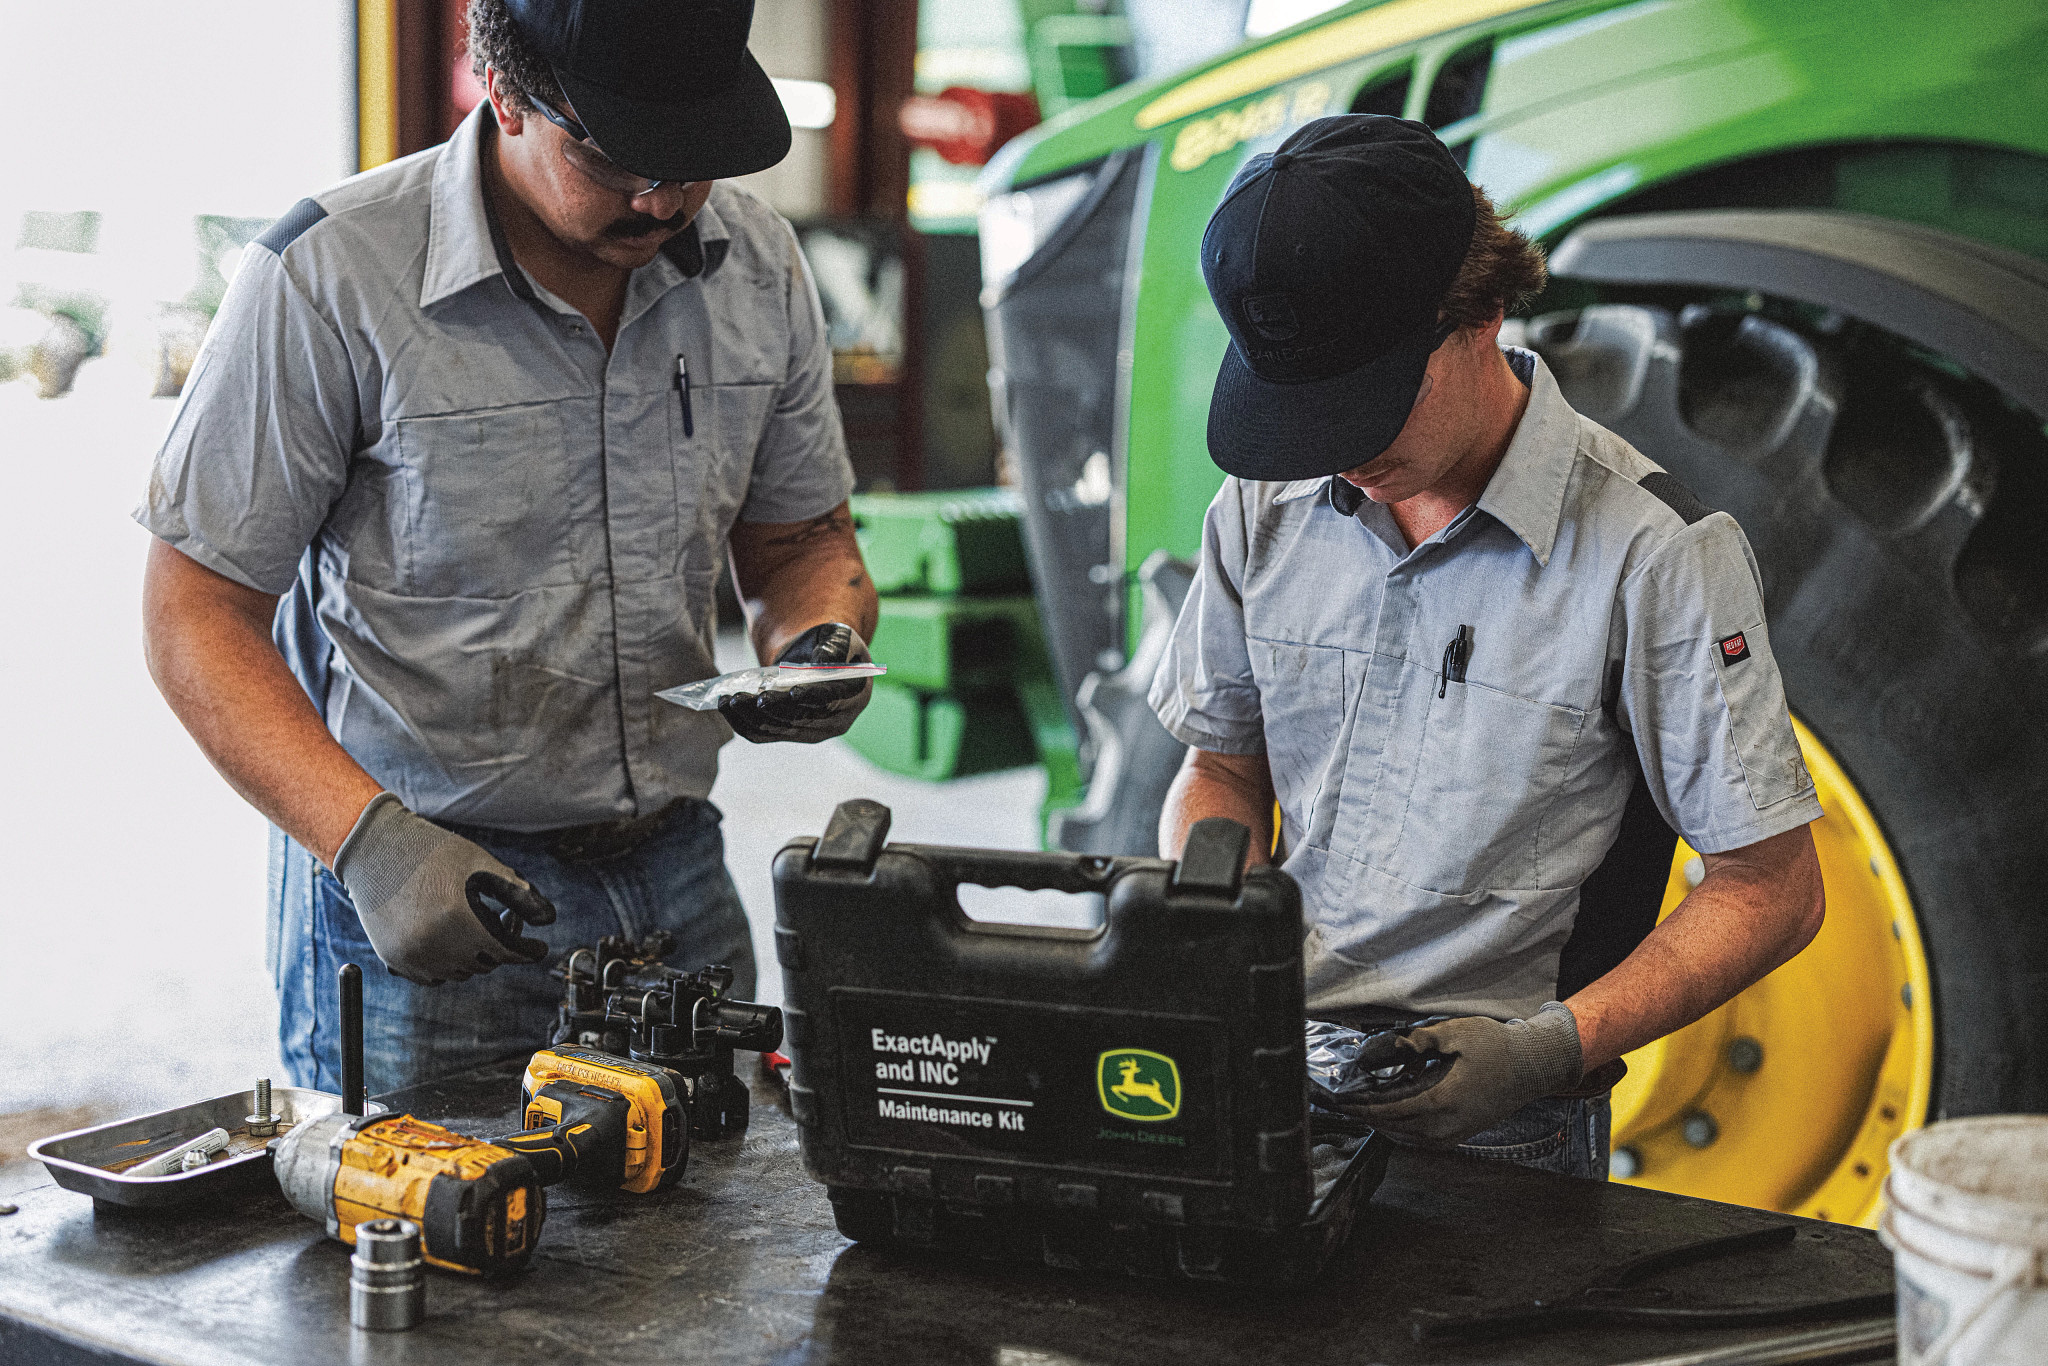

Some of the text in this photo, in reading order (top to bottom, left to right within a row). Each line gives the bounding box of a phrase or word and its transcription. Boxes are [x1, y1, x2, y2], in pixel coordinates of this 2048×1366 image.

[876, 1059, 959, 1086] and INC
[878, 1099, 1025, 1131] Maintenance Kit
